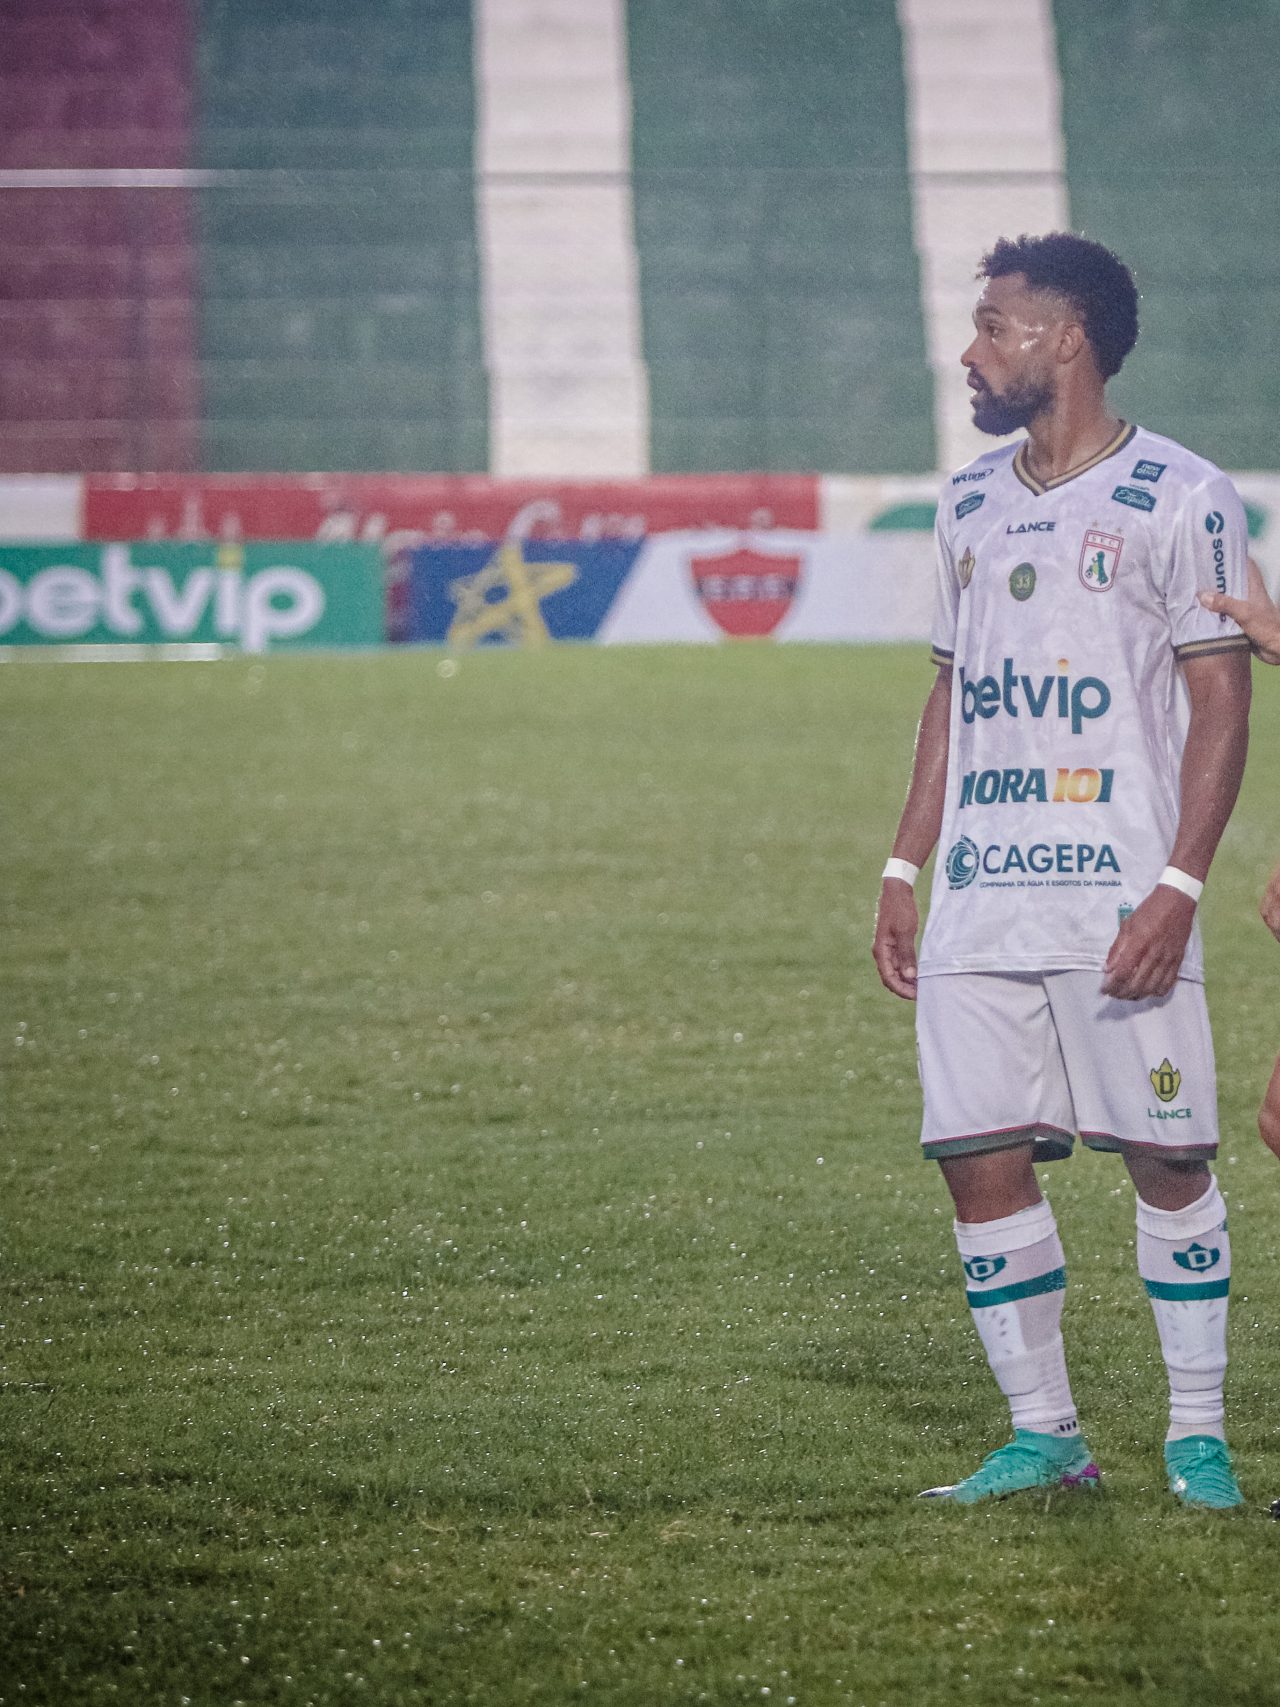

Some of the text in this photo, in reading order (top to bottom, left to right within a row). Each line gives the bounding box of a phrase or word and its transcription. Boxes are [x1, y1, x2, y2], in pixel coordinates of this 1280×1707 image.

[1006, 521, 1056, 535] LANCE
[0, 545, 326, 655] etvip
[958, 658, 1112, 735] betvip
[983, 843, 1122, 875] CAGEPA
[1147, 1107, 1192, 1120] LANCE
